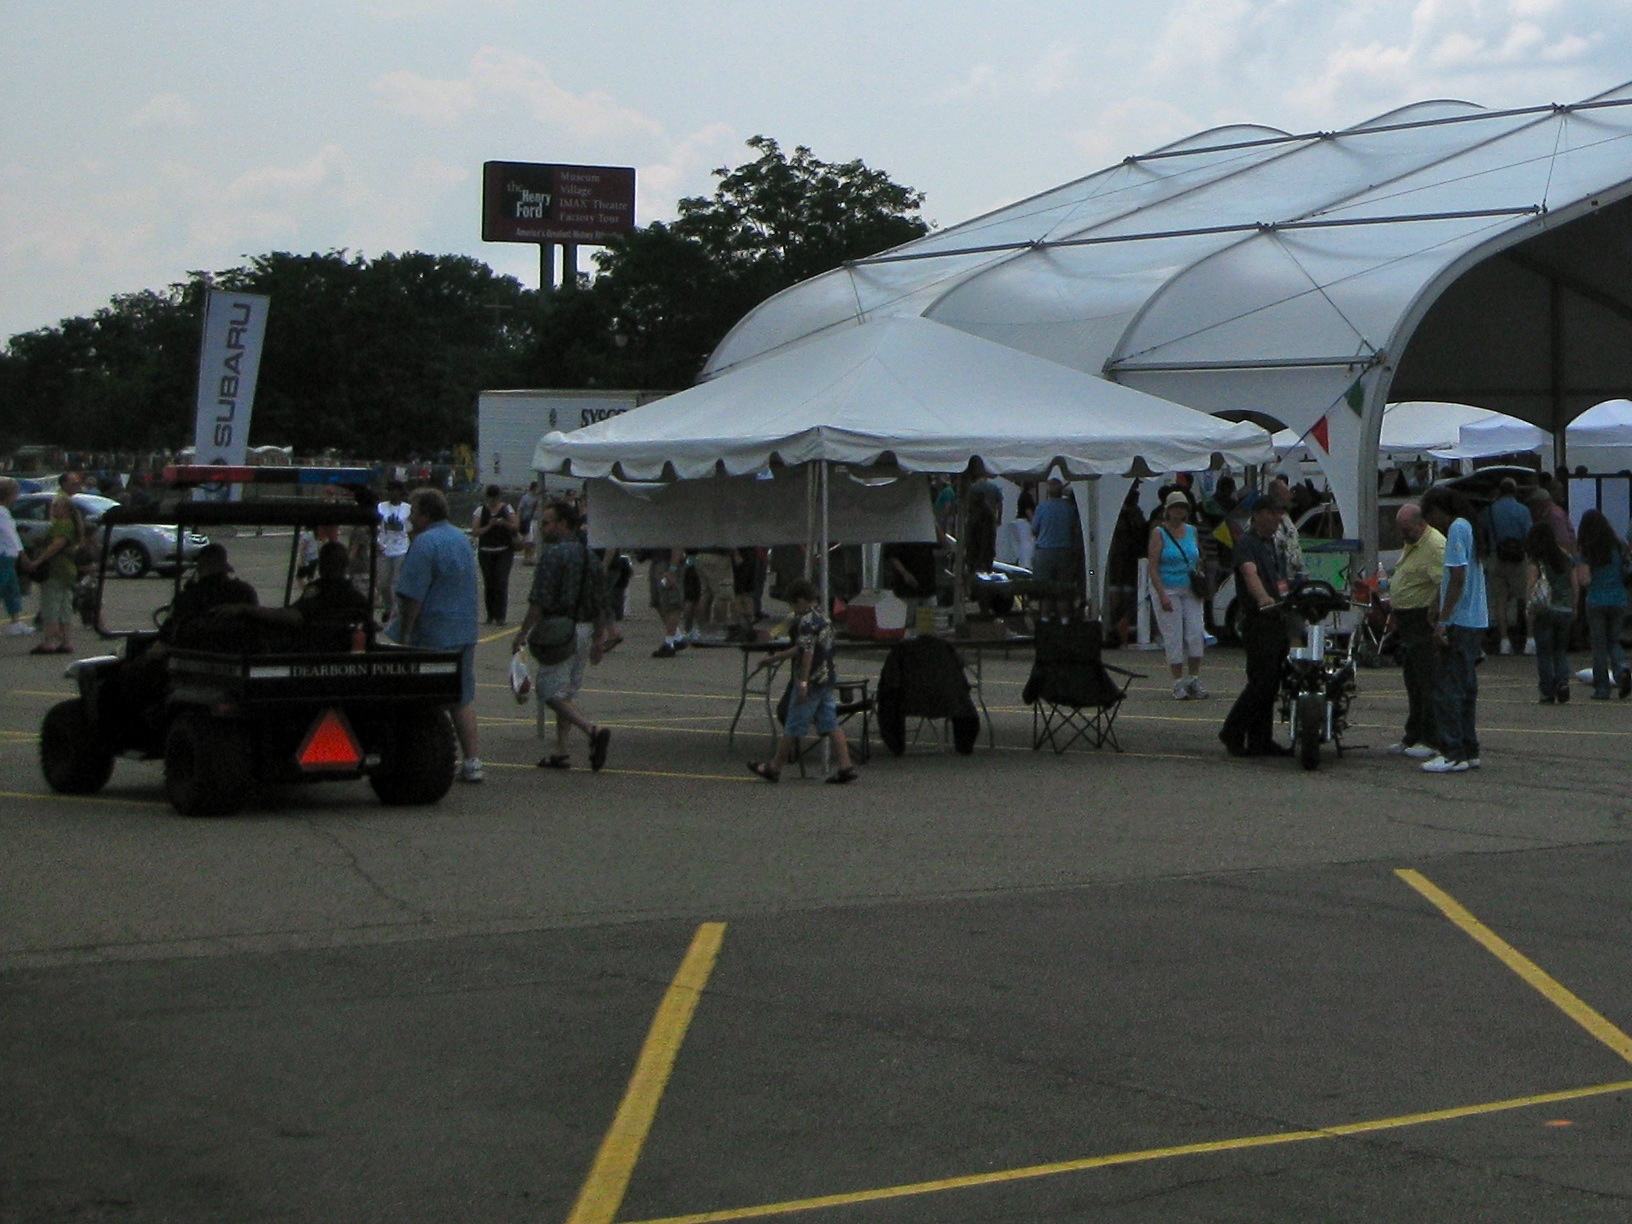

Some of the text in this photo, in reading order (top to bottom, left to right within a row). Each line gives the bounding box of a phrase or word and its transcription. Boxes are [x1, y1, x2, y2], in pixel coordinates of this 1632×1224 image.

[560, 171, 600, 182] Museum
[506, 180, 522, 192] the
[521, 189, 552, 207] Henry
[516, 200, 543, 218] Ford
[213, 302, 252, 447] SUBARU
[292, 663, 420, 677] DEARBORN POLICE
